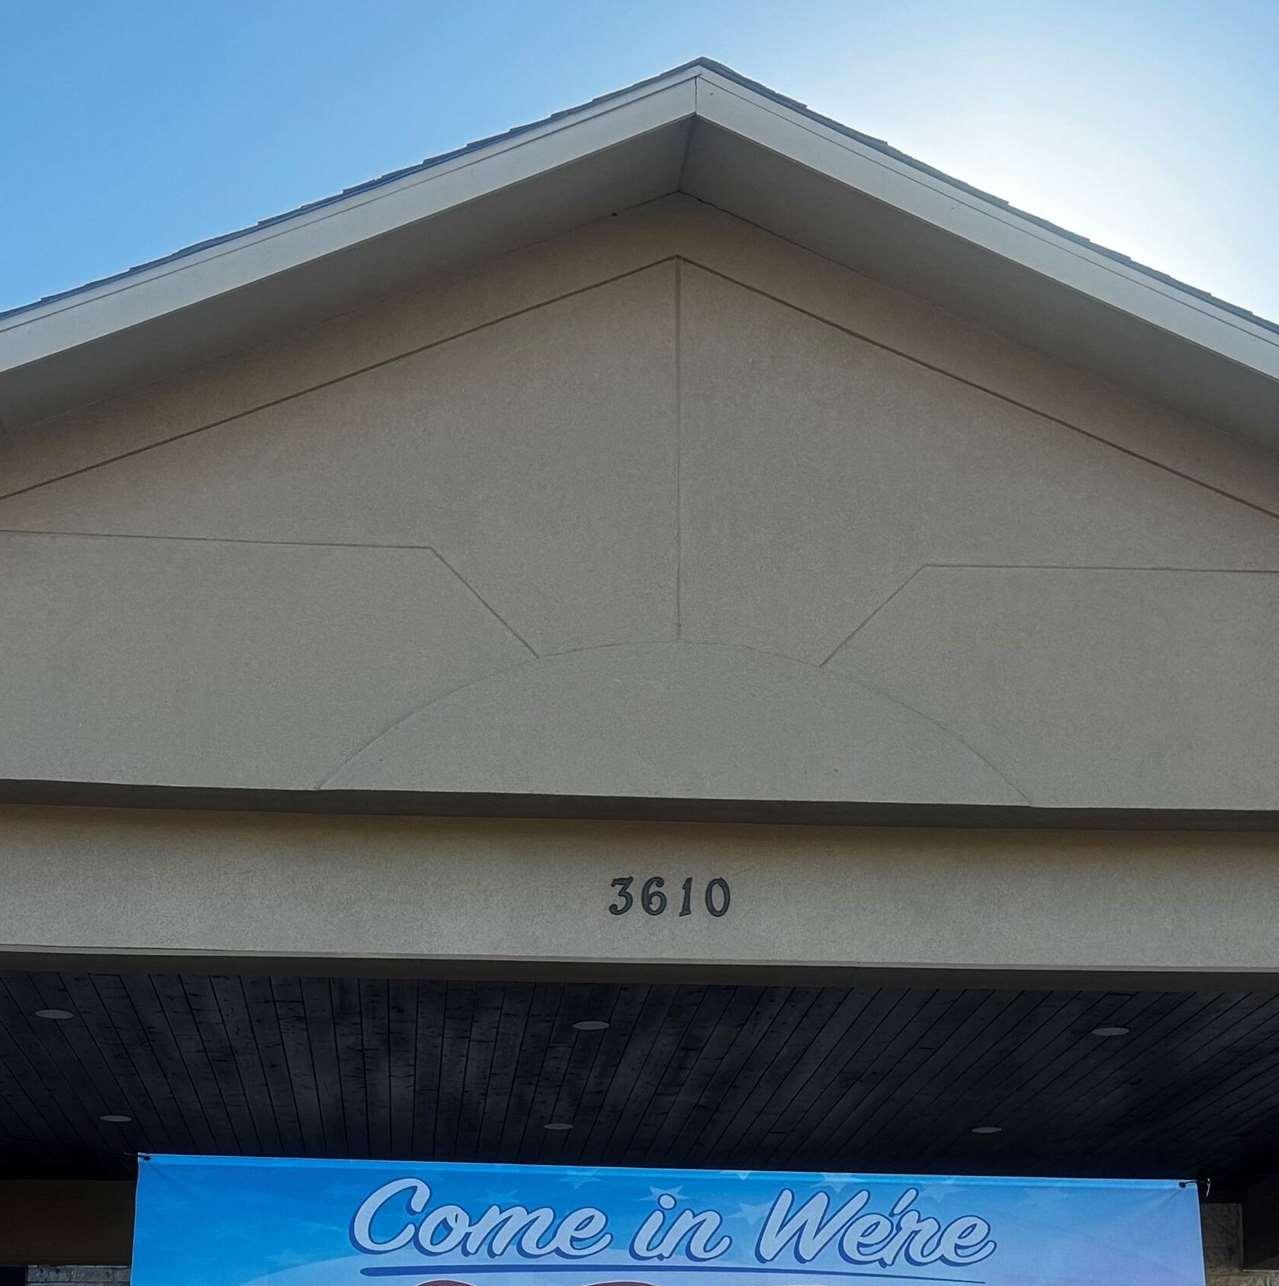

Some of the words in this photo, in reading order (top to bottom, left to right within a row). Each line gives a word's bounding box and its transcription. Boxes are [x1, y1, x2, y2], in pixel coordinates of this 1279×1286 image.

[607, 875, 732, 918] 3610
[351, 1177, 613, 1257] Come
[627, 1194, 731, 1260] in
[755, 1187, 997, 1266] We're
